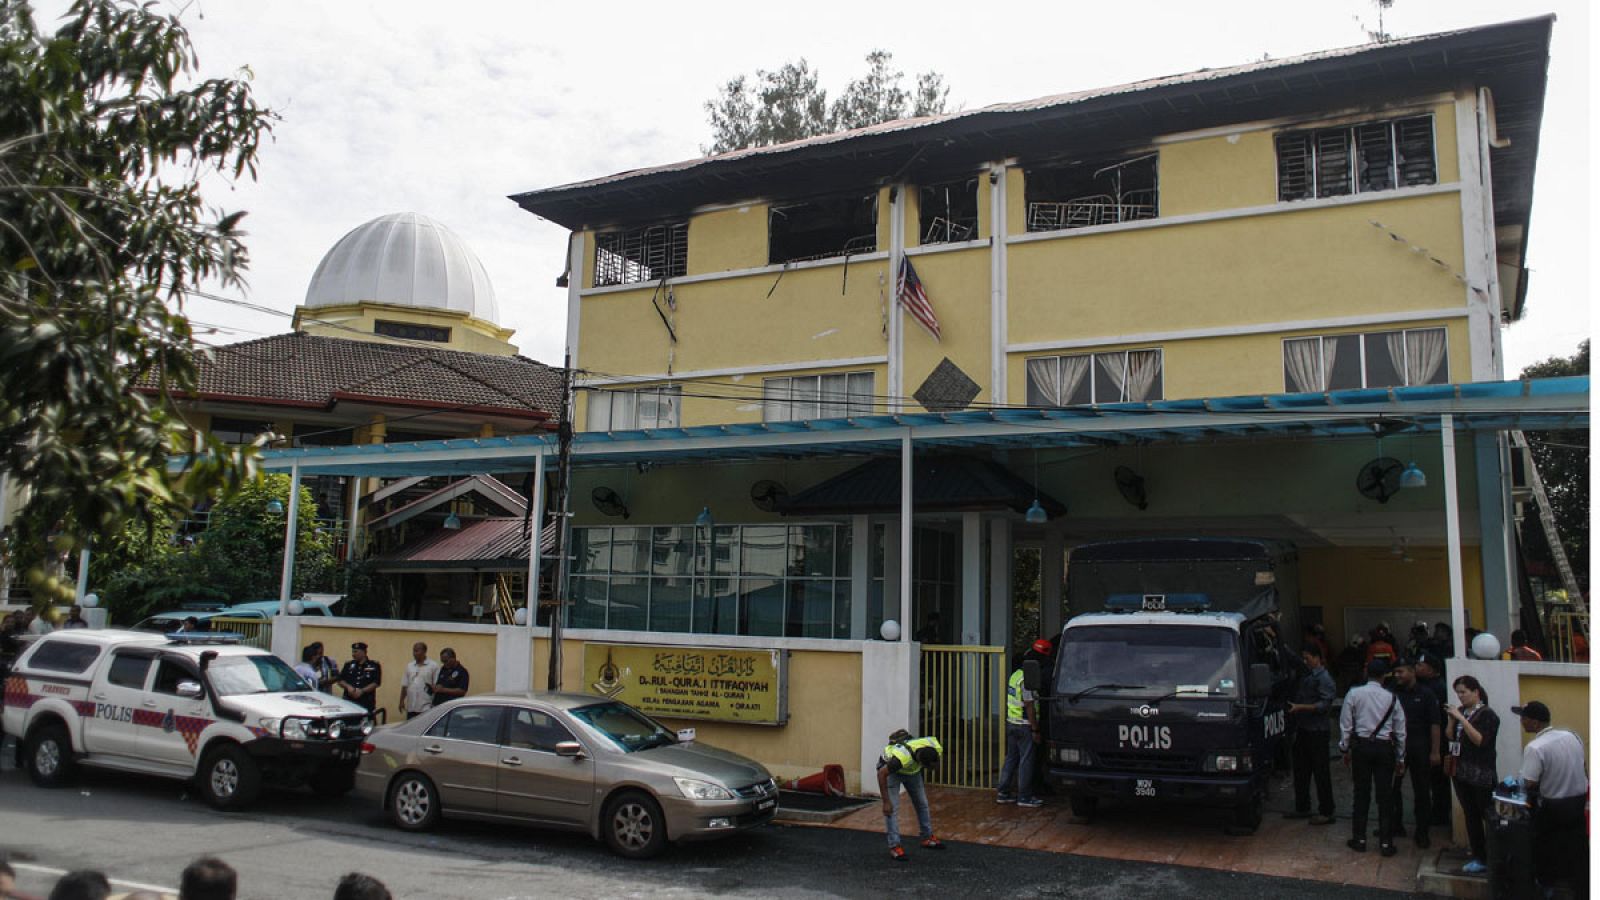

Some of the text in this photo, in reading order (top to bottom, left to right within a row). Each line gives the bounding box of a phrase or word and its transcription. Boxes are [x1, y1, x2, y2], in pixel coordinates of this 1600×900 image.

[710, 679, 768, 693] ITTIFAQIYAH
[96, 703, 133, 723] POLIS
[1264, 709, 1285, 739] POLIS
[1118, 724, 1172, 749] POLIS
[1135, 787, 1156, 797] 3940
